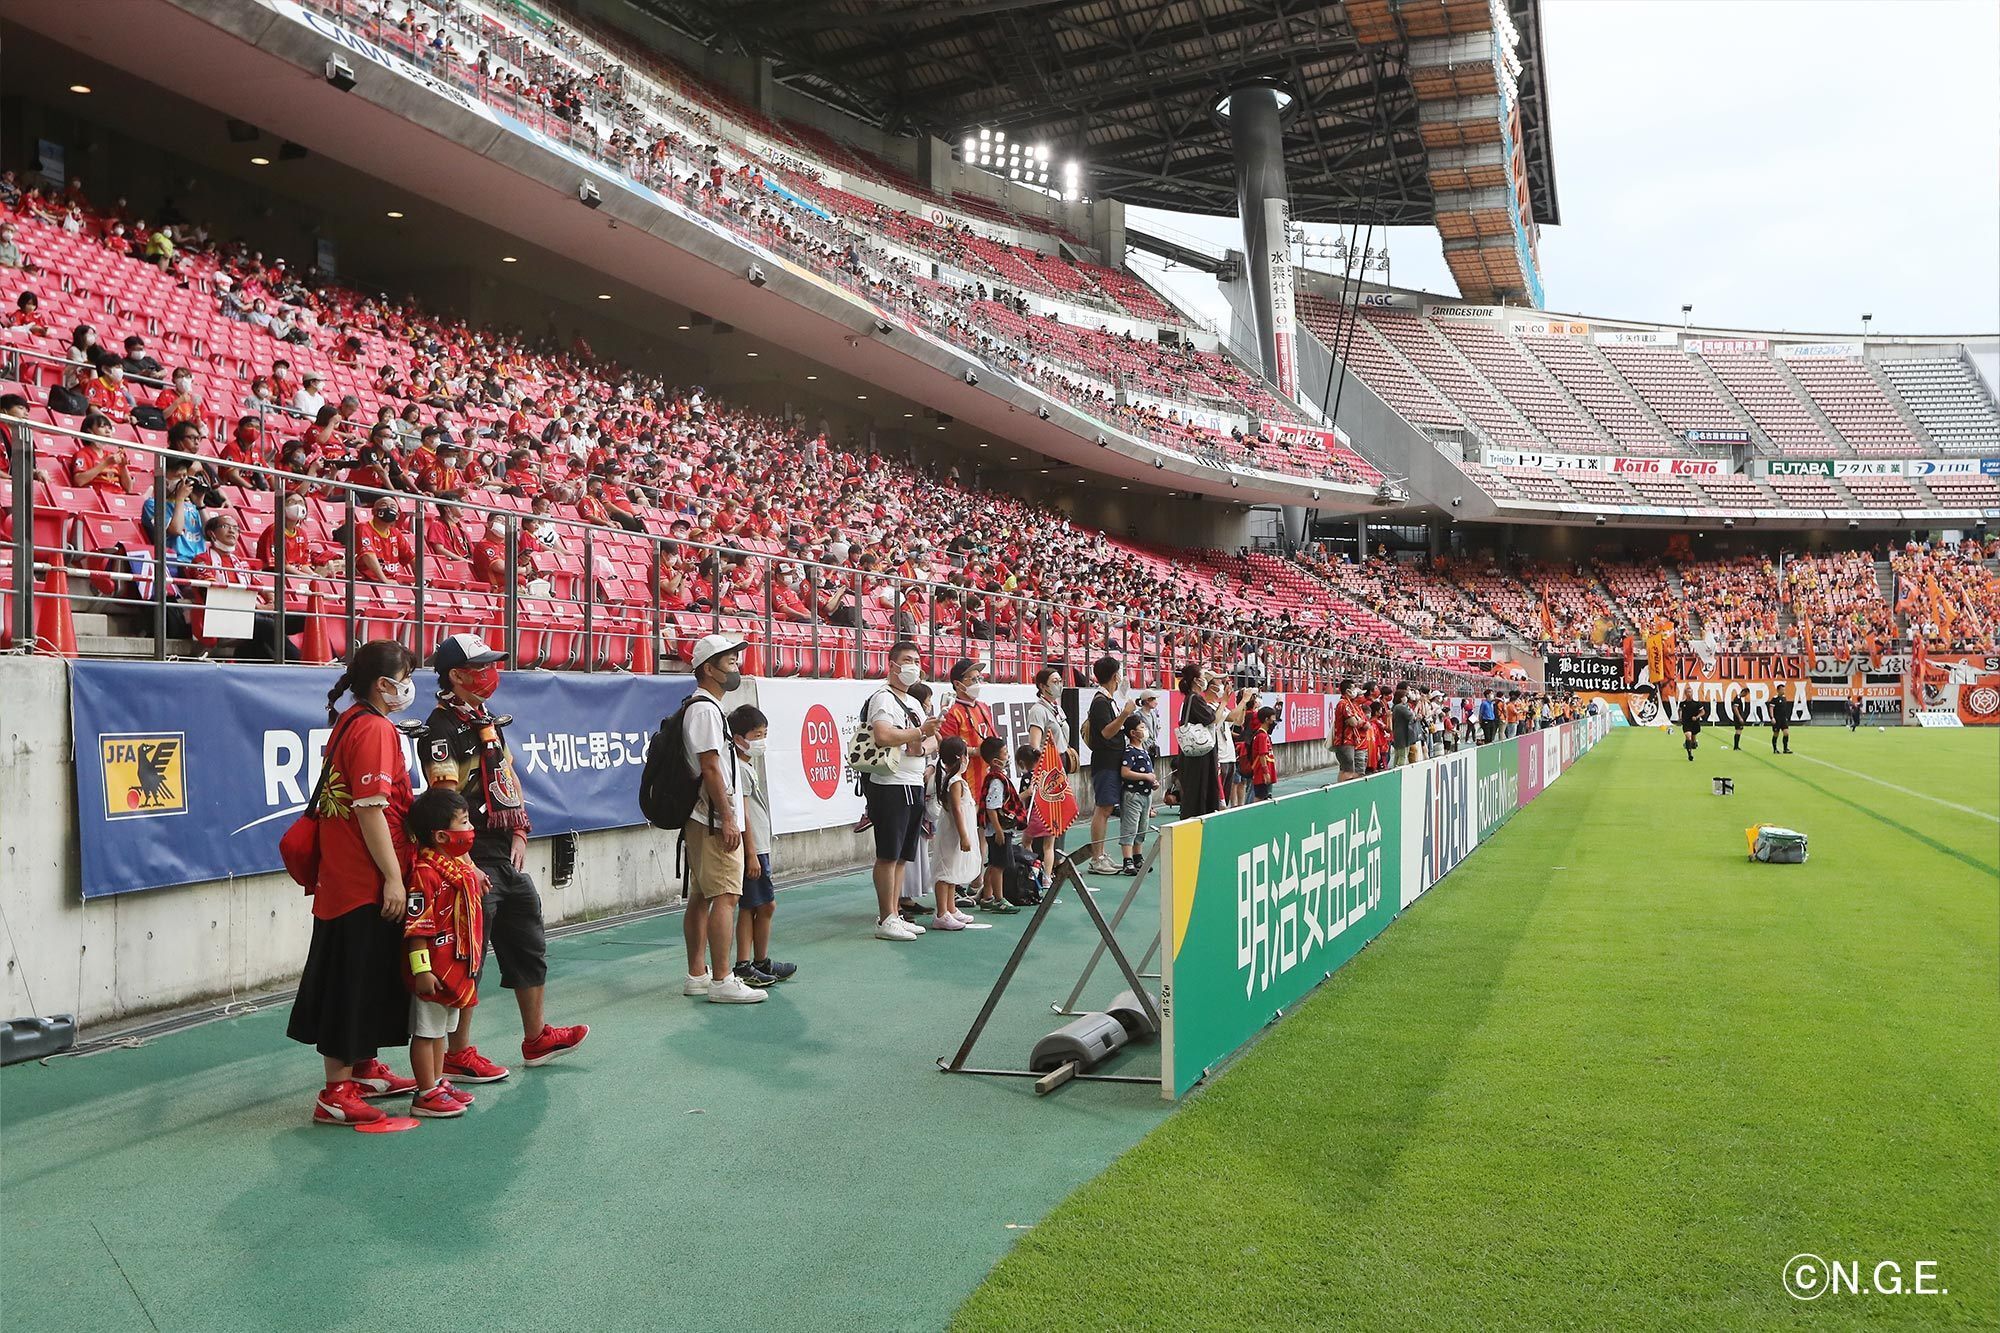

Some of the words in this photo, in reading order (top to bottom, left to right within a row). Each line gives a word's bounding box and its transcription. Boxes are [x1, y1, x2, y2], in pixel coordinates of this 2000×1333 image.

[1271, 251, 1287, 309] 水素社会
[1365, 294, 1393, 306] AGC
[1432, 306, 1494, 316] BRIDGESTONE
[1490, 454, 1515, 465] Trinity
[1519, 455, 1598, 470] トリニティ工業
[1772, 462, 1830, 474] FUTABA
[1837, 463, 1901, 474] フタバ産業
[1435, 644, 1489, 660] 愛知トヨタ
[1559, 657, 1618, 675] Believe
[1719, 656, 1802, 681] ULTRAS
[1817, 687, 1850, 696] UNITED
[1852, 687, 1864, 696] WE
[1866, 687, 1896, 697] STAND
[807, 721, 833, 745] DO!
[106, 744, 138, 763] JFA
[522, 731, 651, 774] 大切に思うこと
[815, 748, 829, 763] ALL
[809, 765, 838, 782] SPORTS
[1236, 800, 1383, 1001] 明治安田生命
